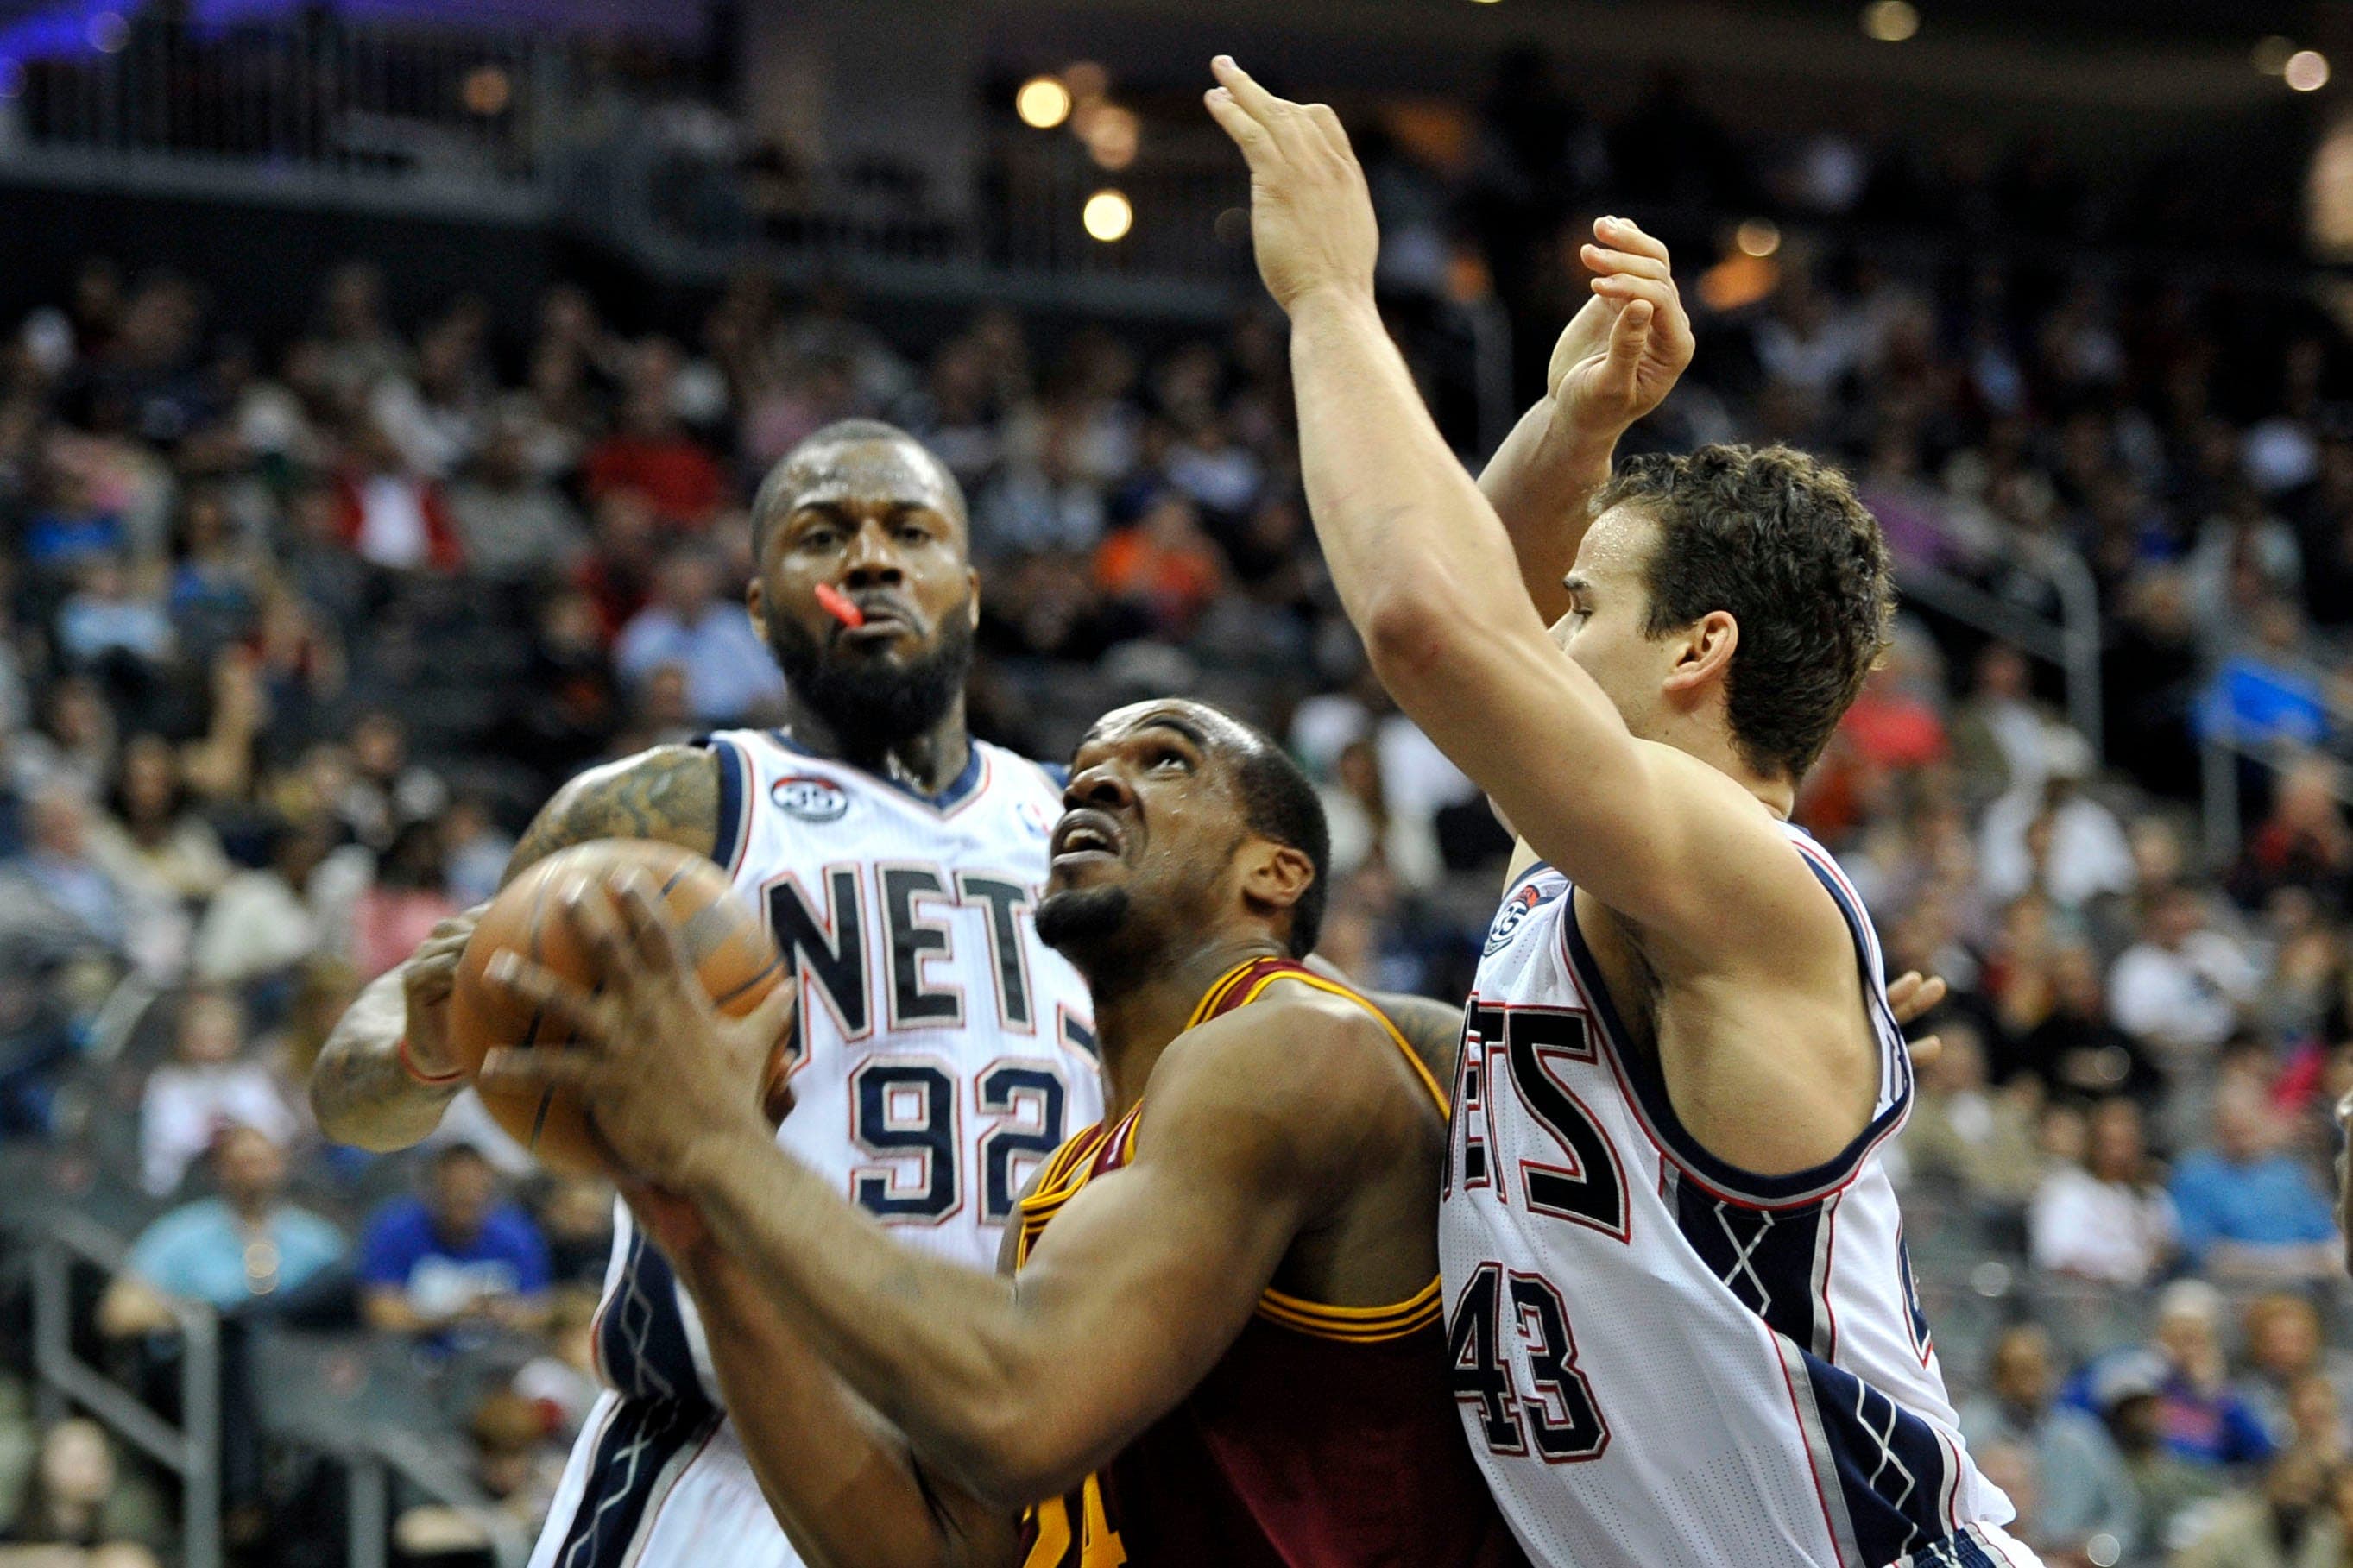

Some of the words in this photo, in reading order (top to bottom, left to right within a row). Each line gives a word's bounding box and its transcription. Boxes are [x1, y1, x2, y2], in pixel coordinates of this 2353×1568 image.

[760, 861, 1101, 1074] NET
[849, 1053, 1069, 1226] 92
[1447, 1260, 1612, 1464] 43
